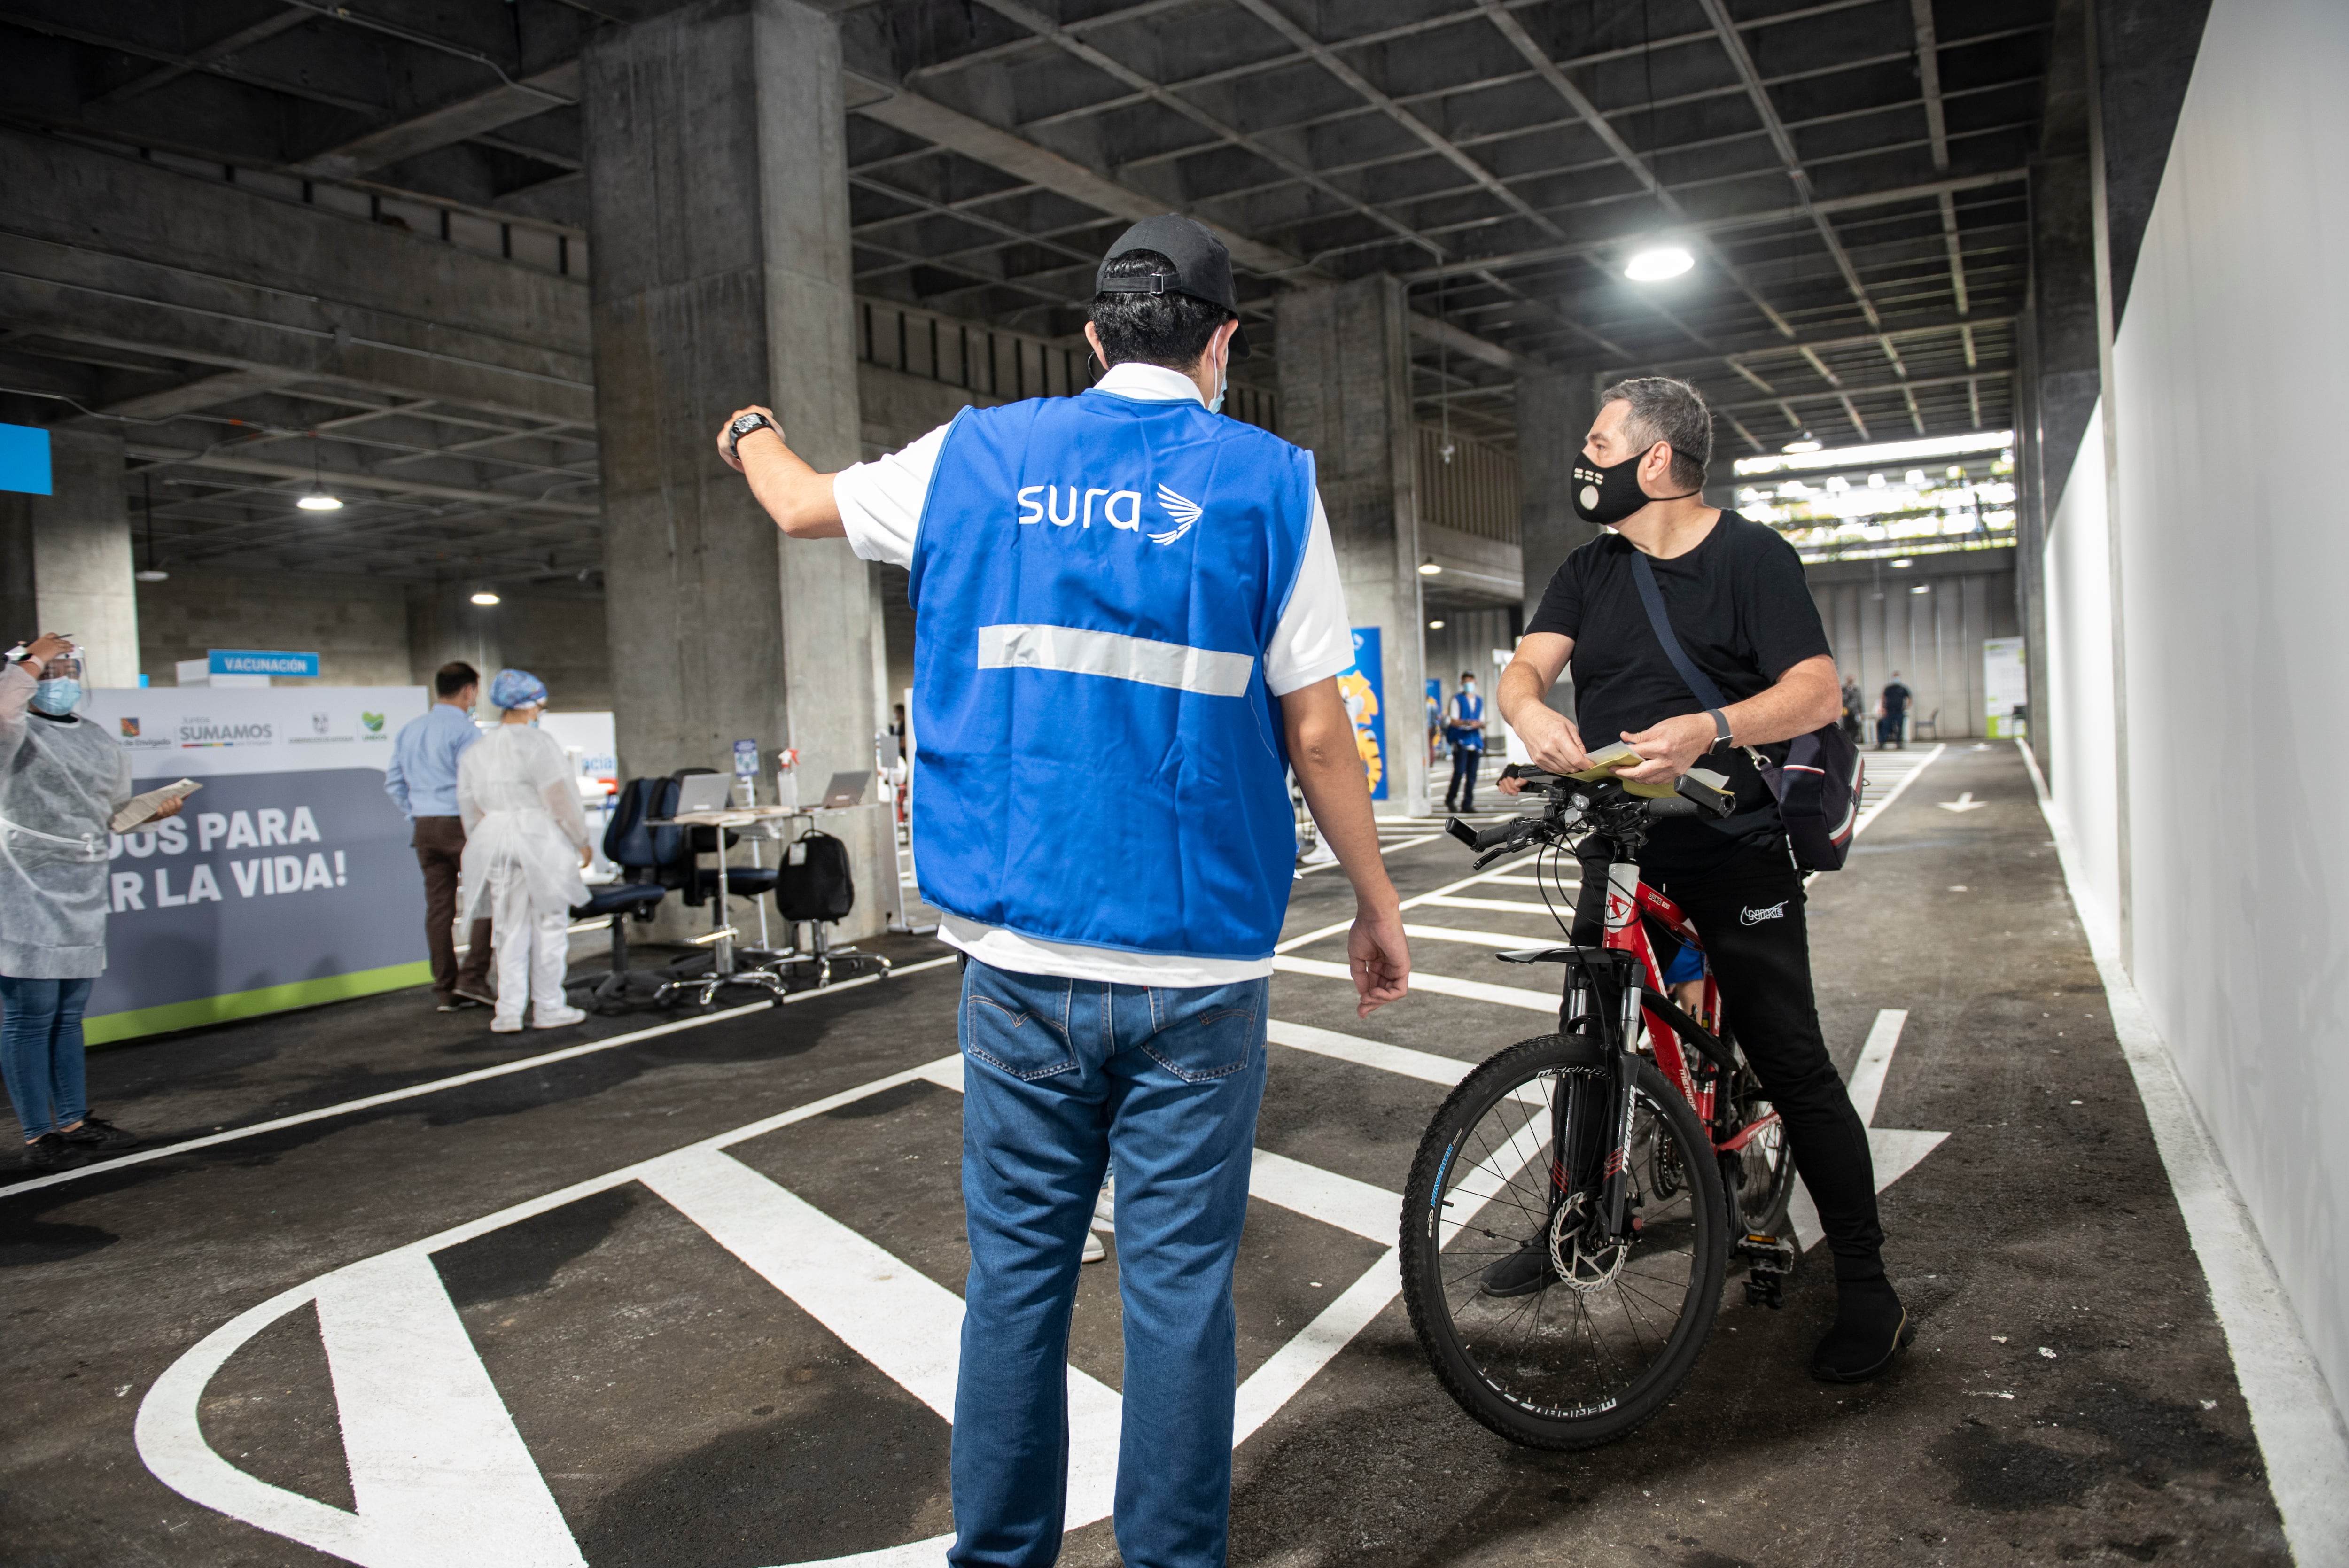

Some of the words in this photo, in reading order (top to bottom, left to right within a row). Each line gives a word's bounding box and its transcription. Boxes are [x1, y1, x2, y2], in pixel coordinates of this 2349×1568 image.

[1017, 484, 1142, 532] sura
[224, 657, 308, 673] VACUNACIÓN
[179, 723, 272, 741] SUMAMOS
[197, 805, 321, 852] PARA
[155, 863, 223, 908] LA
[230, 850, 348, 898] VIDA!
[1648, 892, 1663, 906] DUKE
[1748, 907, 1784, 921] NIKE
[1622, 1084, 1636, 1175] MERIDA
[1430, 1143, 1454, 1208] MAVERICK
